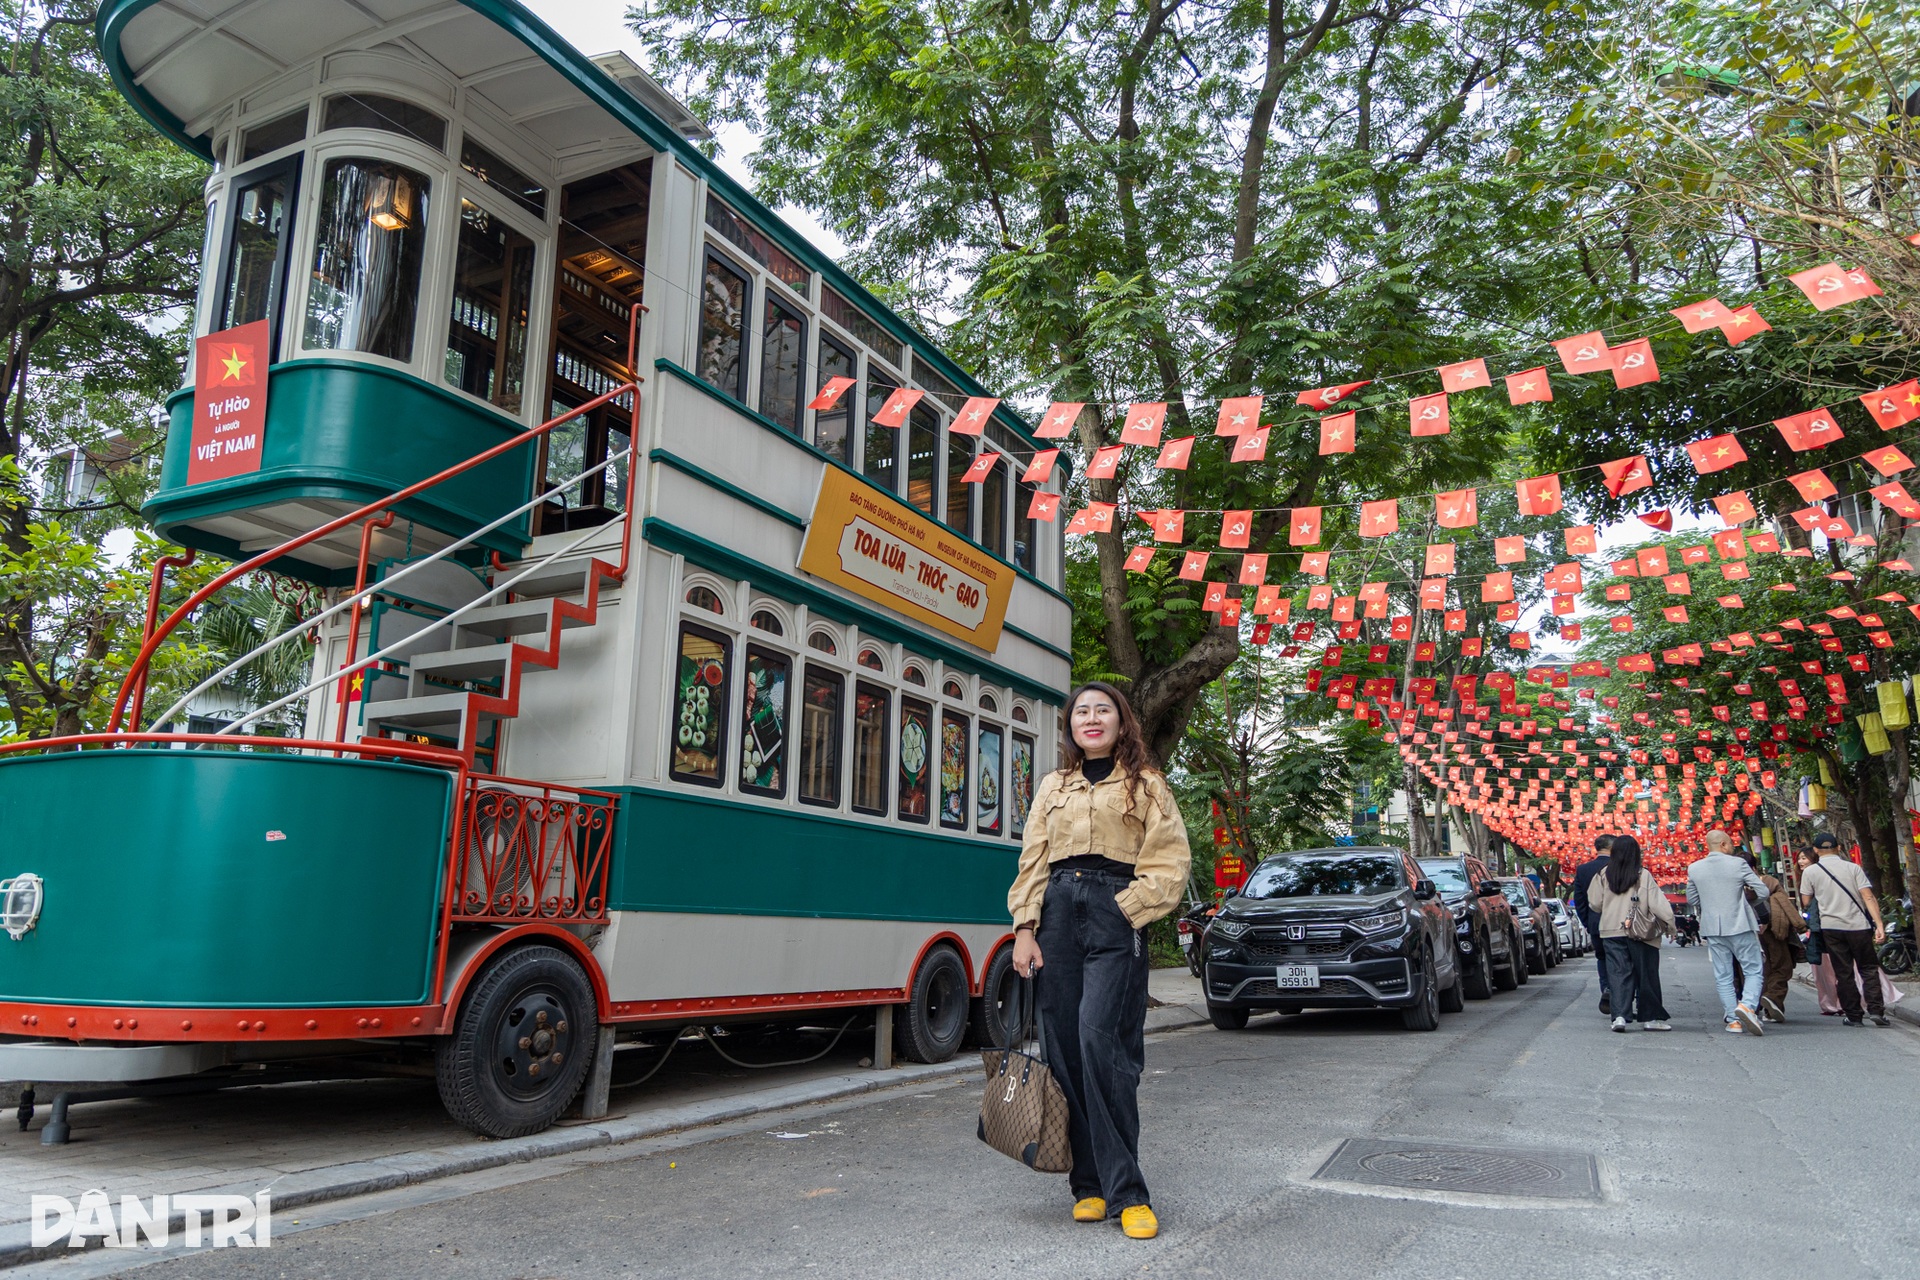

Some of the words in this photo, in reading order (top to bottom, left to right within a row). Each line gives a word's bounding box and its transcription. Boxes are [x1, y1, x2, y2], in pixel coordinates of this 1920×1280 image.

[208, 402, 224, 420] Tự
[225, 395, 250, 414] Hào
[214, 424, 222, 434] LÀ
[222, 420, 240, 432] NGƯỜI
[198, 439, 223, 462] VIỆT
[225, 434, 256, 454] NAM
[896, 518, 908, 532] PHỐ
[854, 528, 881, 561] TOA
[882, 543, 906, 574] LÚA
[917, 561, 948, 596] THÓC
[956, 582, 980, 609] GẠO
[937, 540, 957, 558] MUSEUM
[956, 552, 964, 562] OF
[981, 566, 998, 580] STREETS
[892, 578, 912, 596] Tramcar
[1288, 968, 1307, 977] 30H
[1282, 977, 1314, 987] 959.81
